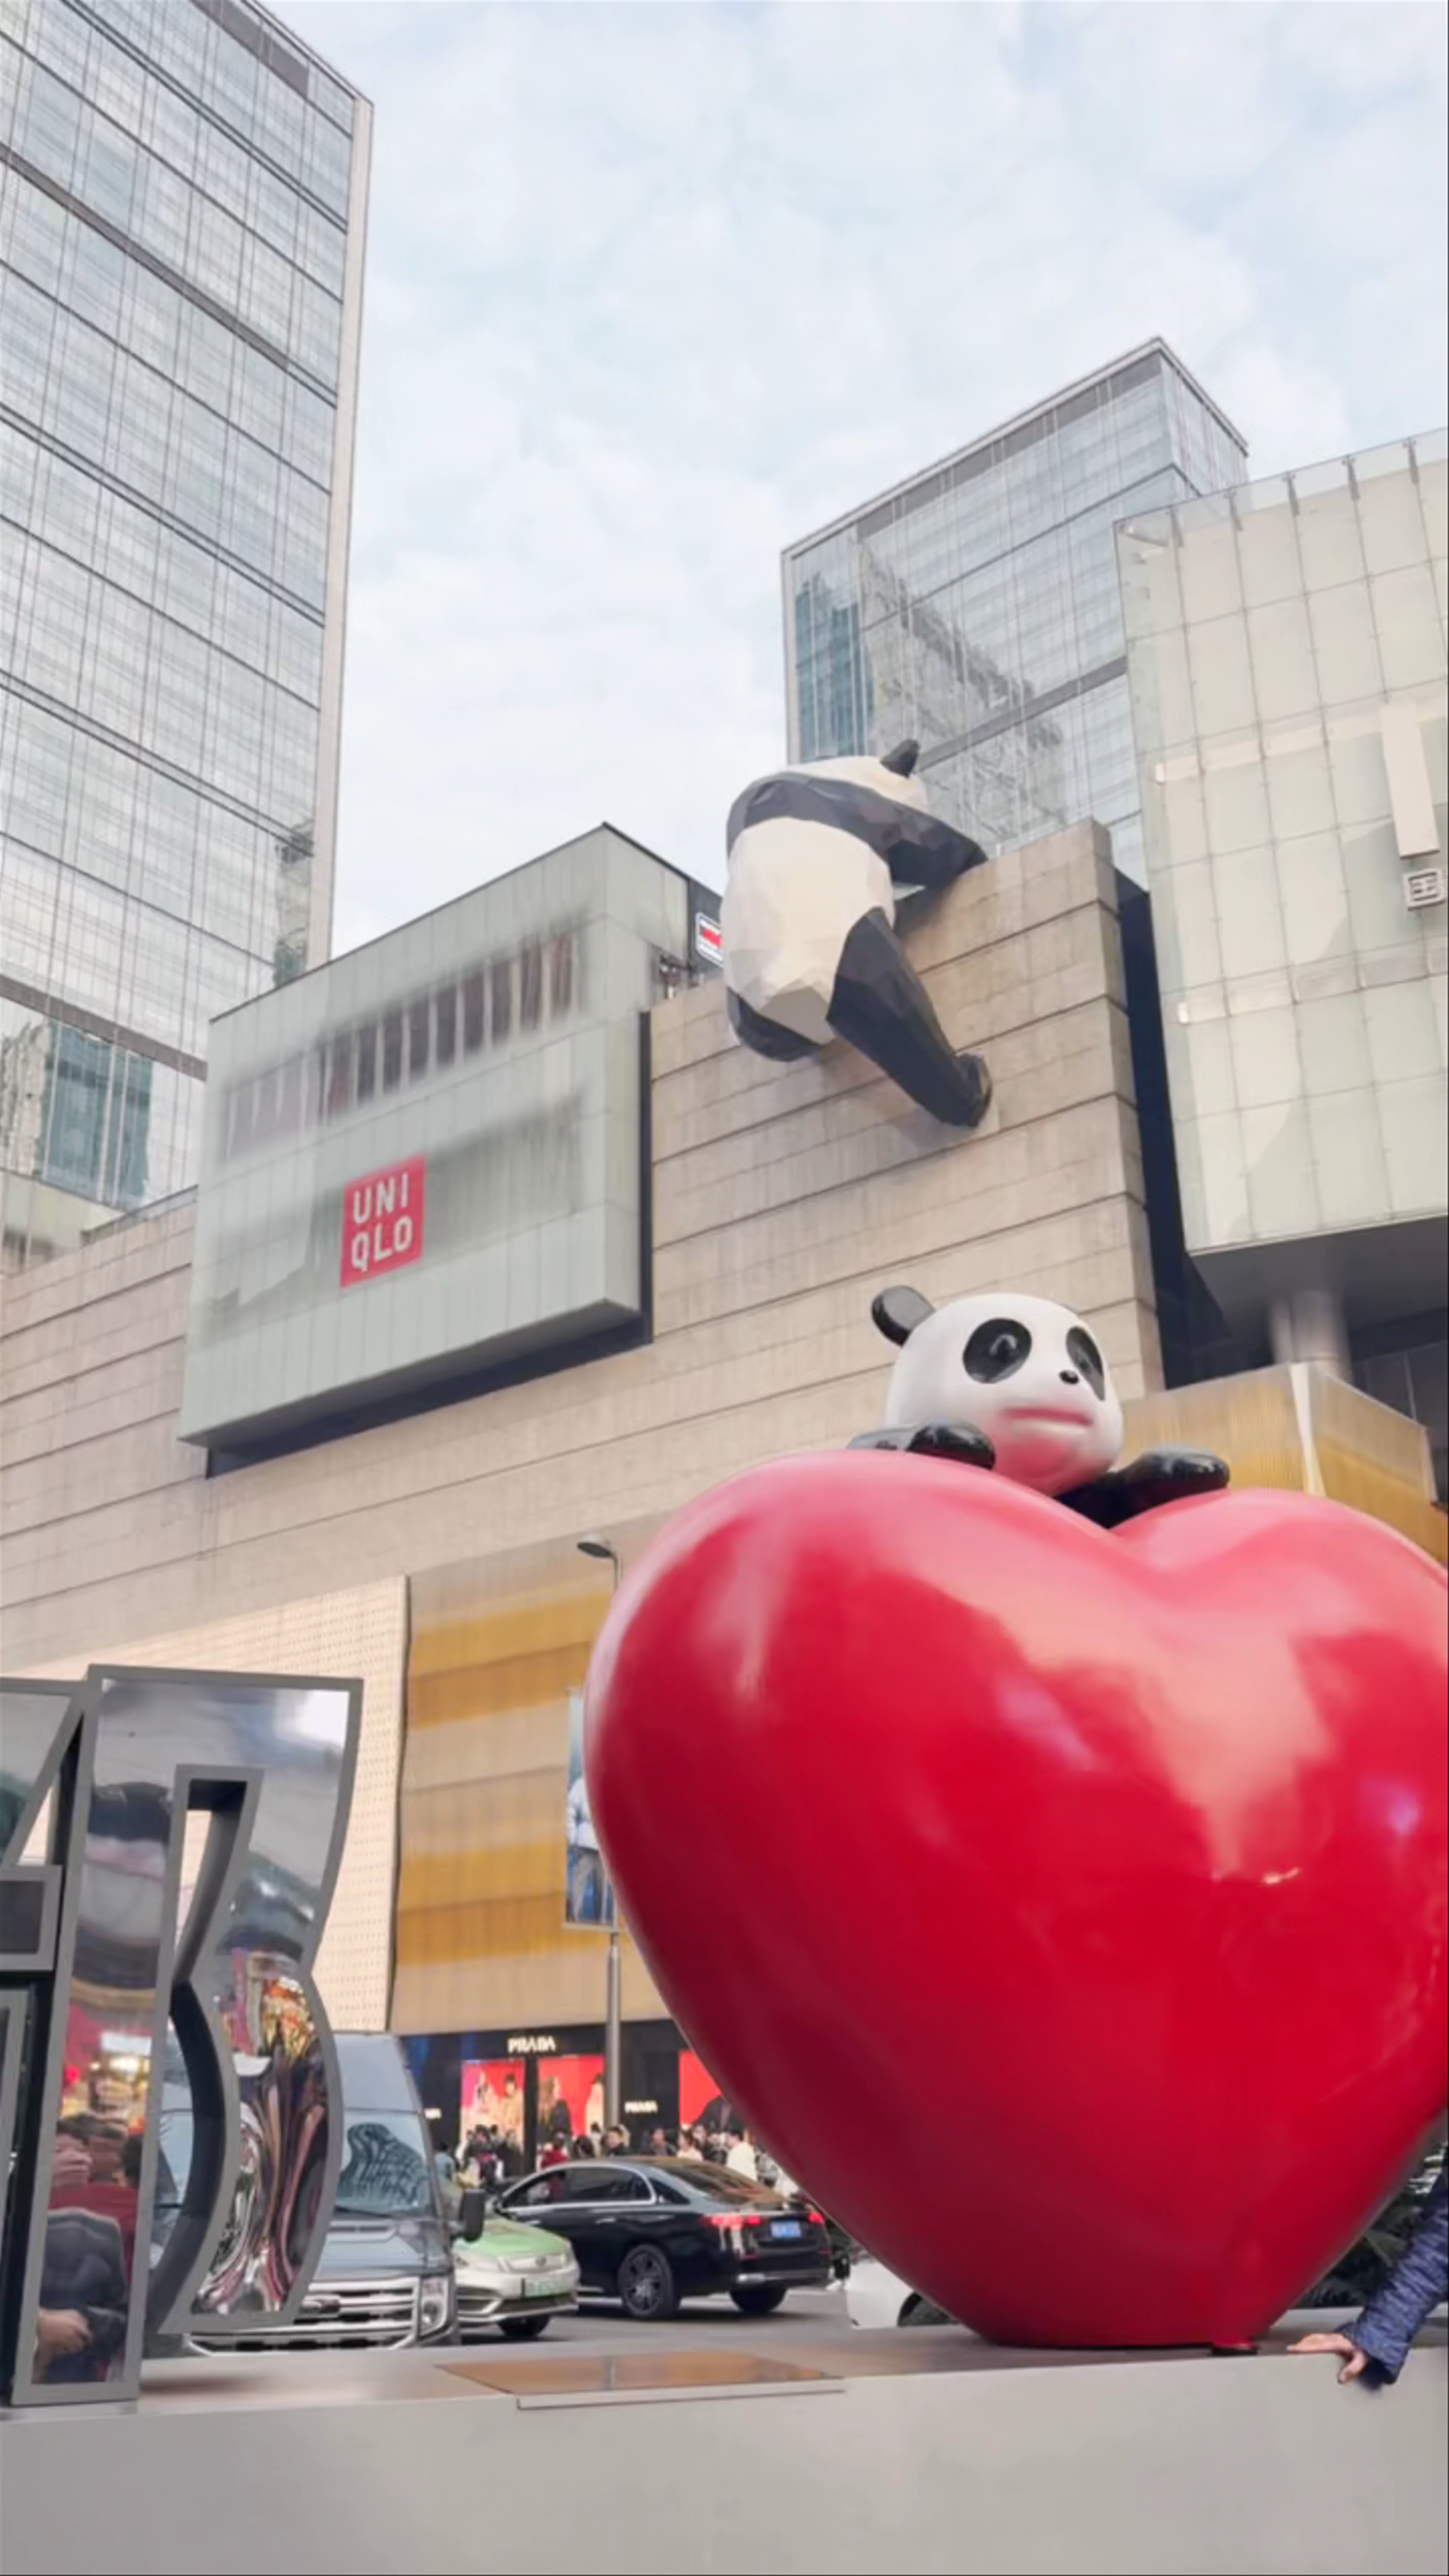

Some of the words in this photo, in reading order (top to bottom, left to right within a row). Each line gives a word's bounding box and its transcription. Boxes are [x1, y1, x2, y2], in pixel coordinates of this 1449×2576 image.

[353, 1172, 409, 1224] UNI
[351, 1216, 412, 1272] QLO
[508, 2036, 555, 2053] PRADA
